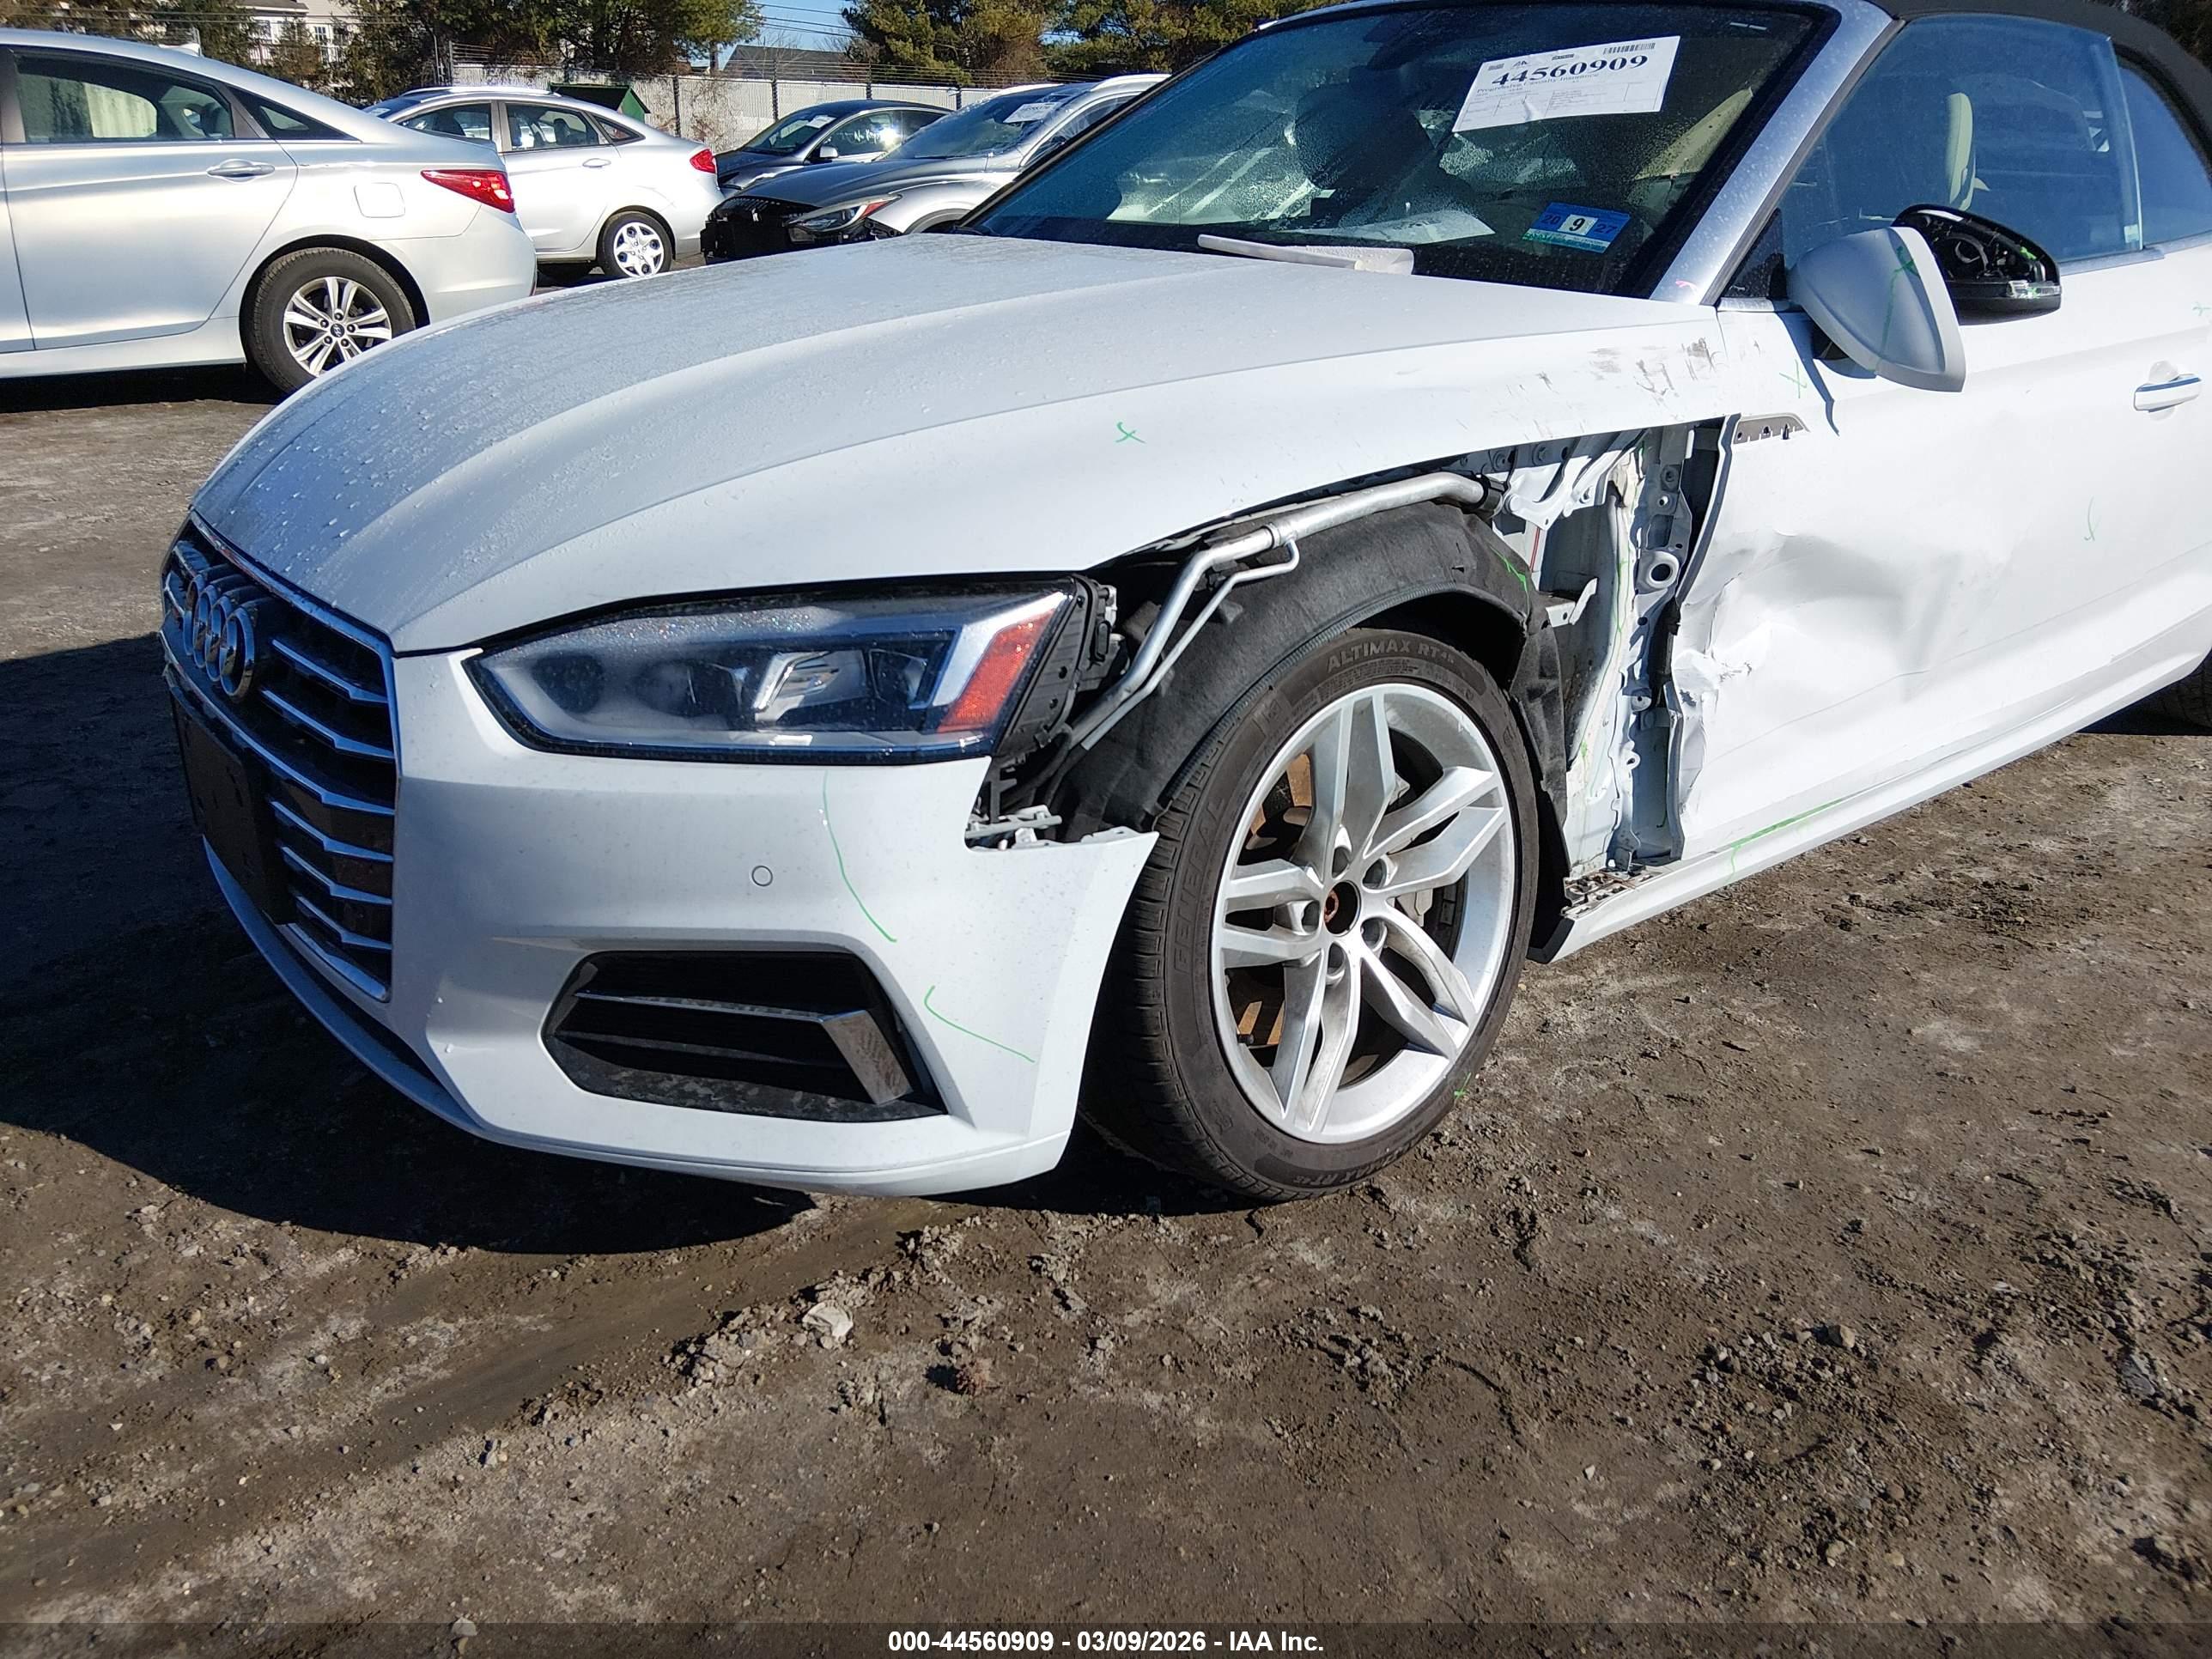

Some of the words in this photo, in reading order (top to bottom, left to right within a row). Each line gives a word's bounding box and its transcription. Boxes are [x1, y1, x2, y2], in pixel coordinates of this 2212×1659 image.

[1492, 55, 1648, 85] 44560909
[1542, 215, 1561, 225] 20
[1568, 217, 1586, 232] 9
[1595, 223, 1618, 234] 27
[1327, 639, 1411, 673] ALTIMAX
